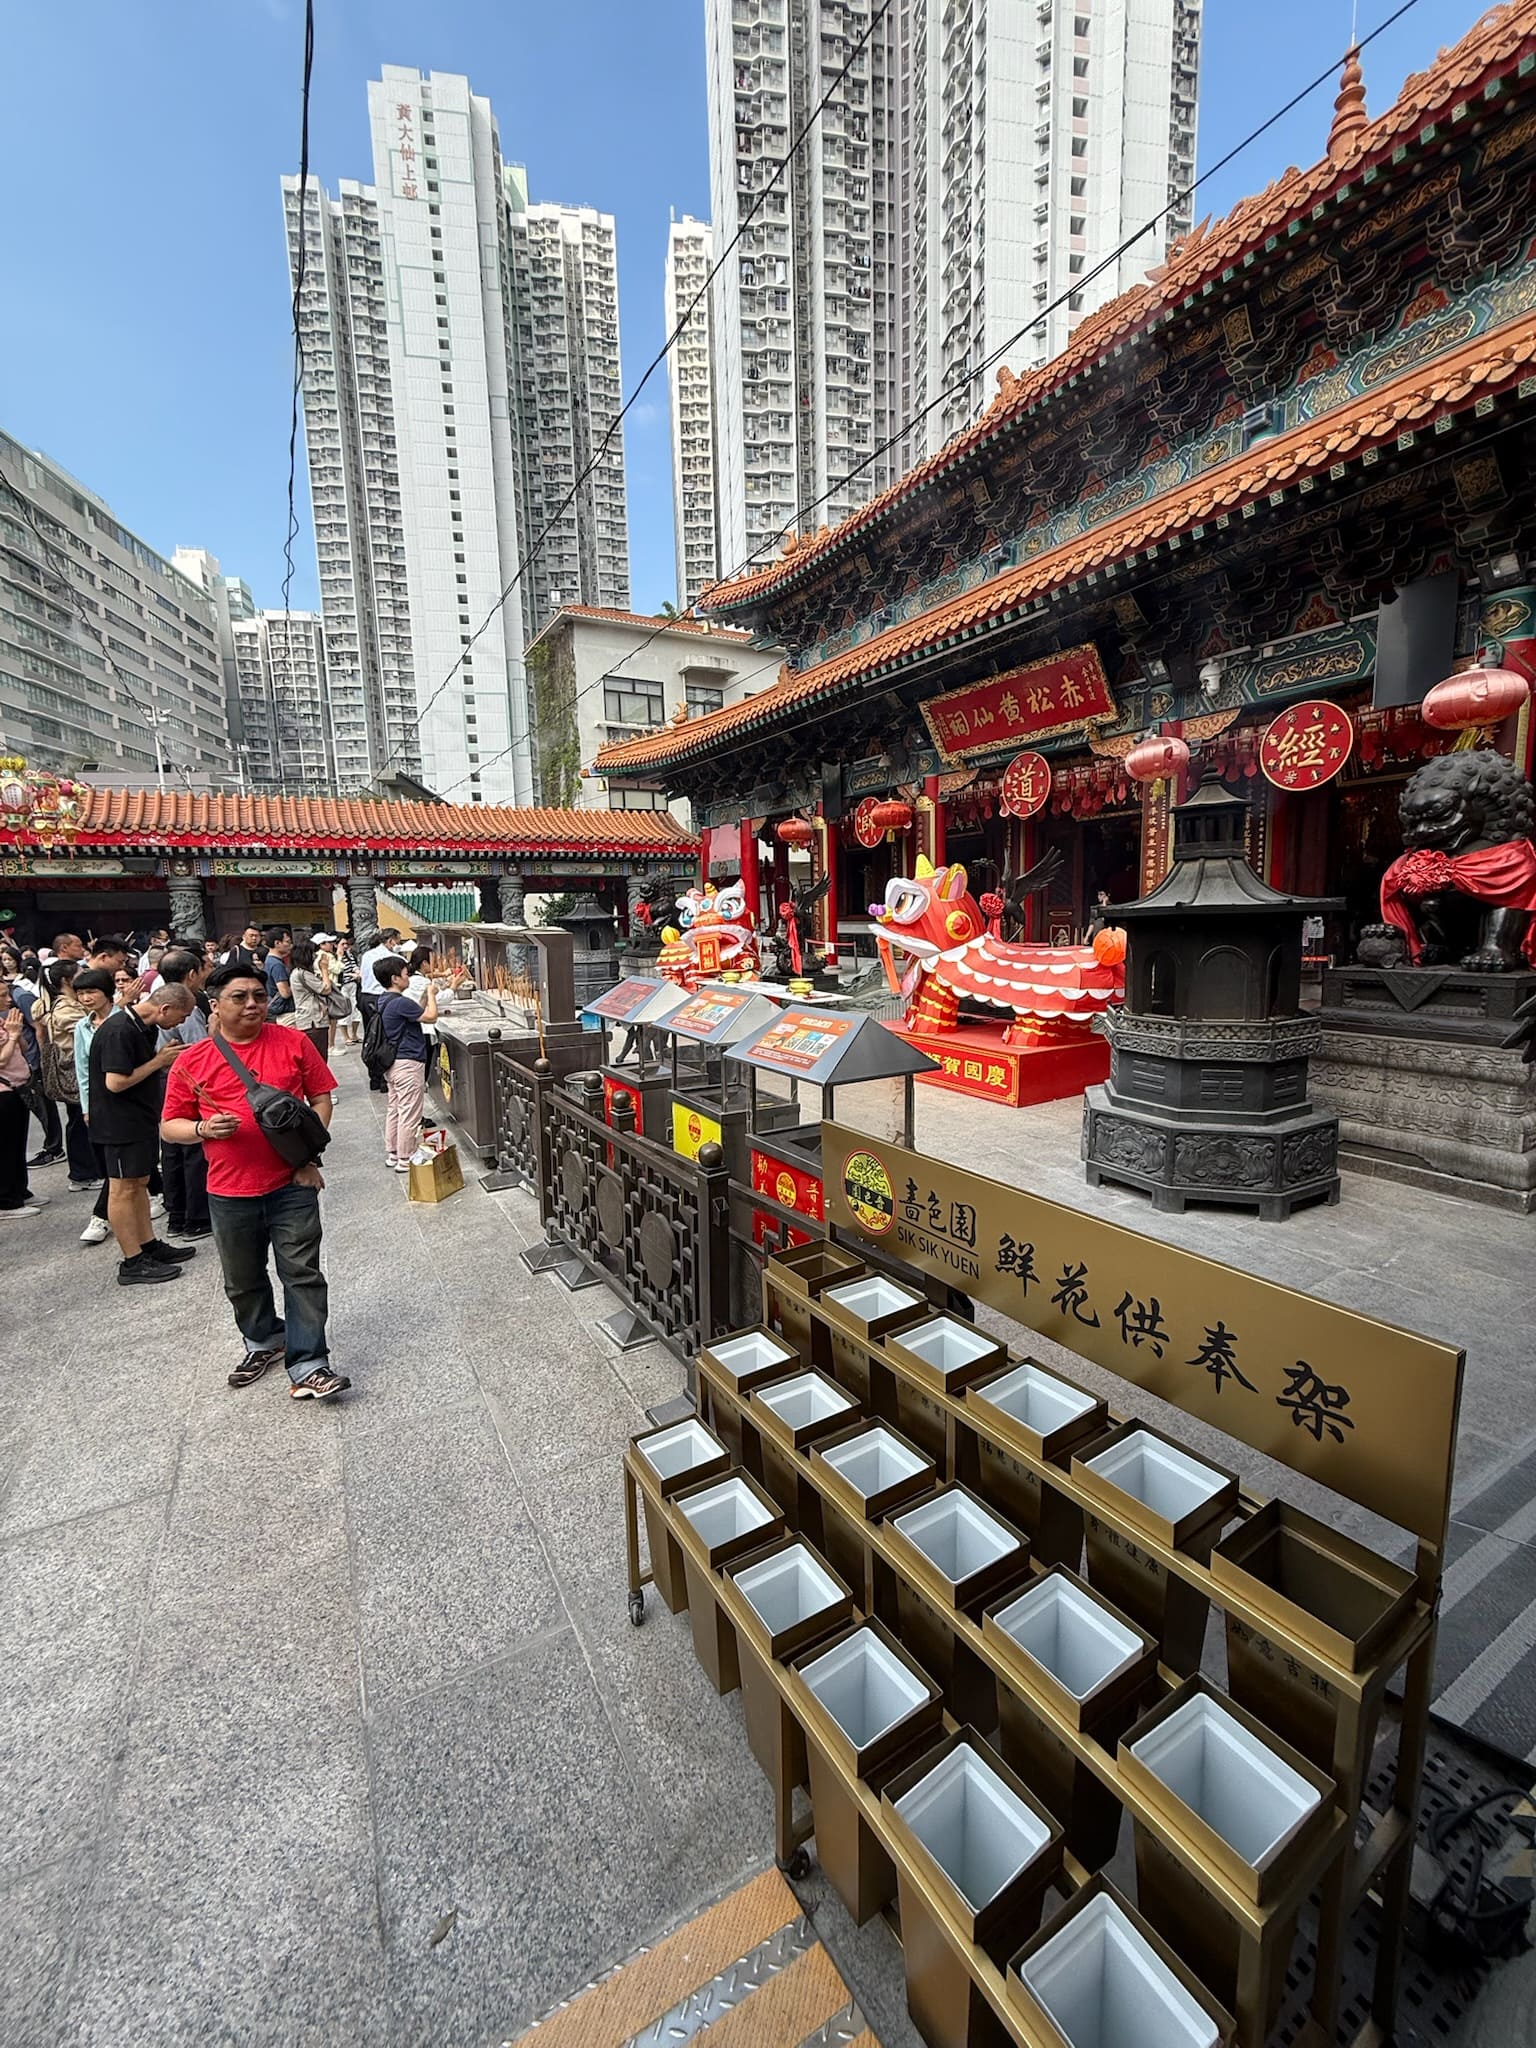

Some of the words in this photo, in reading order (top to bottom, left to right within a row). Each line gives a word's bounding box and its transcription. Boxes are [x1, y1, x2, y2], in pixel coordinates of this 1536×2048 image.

[1277, 723, 1326, 773] 經
[1011, 763, 1041, 804] 道
[897, 1226, 917, 1249] SIK
[919, 1237, 939, 1260] SIK
[940, 1247, 980, 1280] YUEN
[994, 1232, 1355, 1444] 鮮花供奉架
